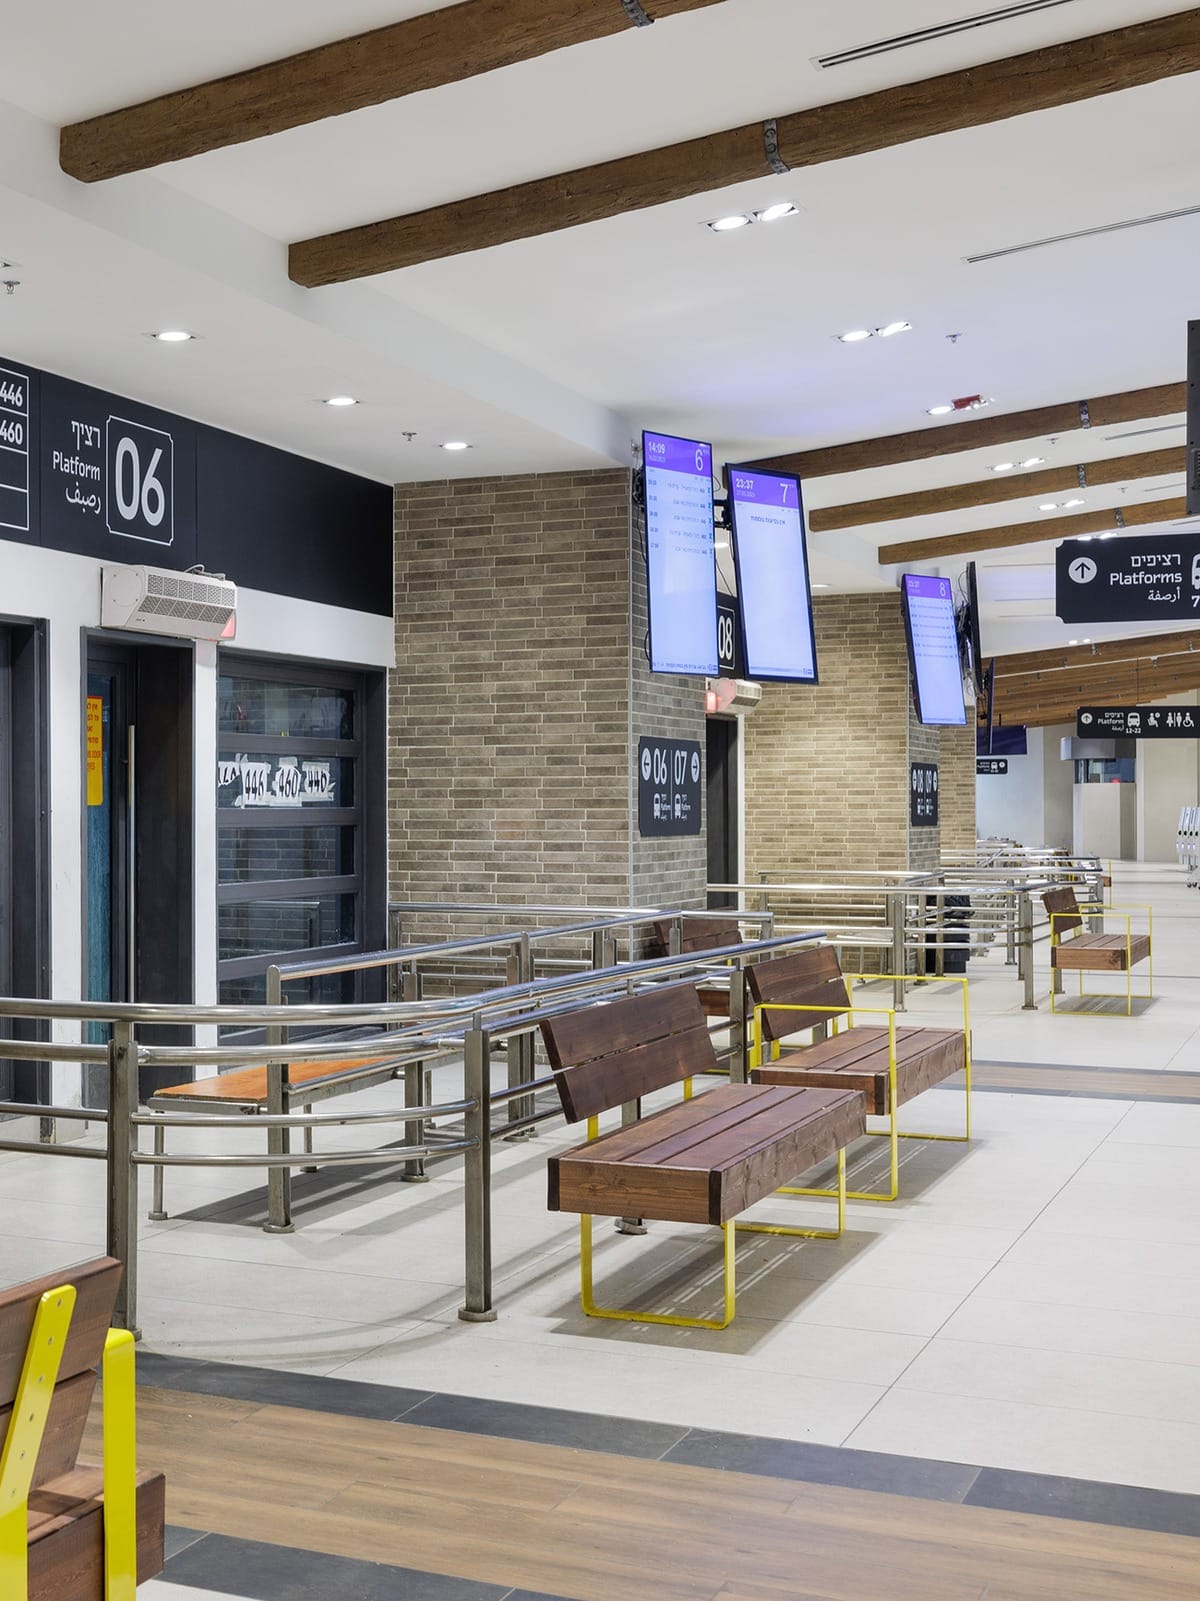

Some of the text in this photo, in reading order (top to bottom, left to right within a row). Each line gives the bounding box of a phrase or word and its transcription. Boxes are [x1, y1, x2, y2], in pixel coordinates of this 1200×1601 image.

[0, 381, 23, 407] 446
[0, 420, 23, 445] 460
[71, 420, 101, 449] רציף
[52, 450, 101, 481] Platform
[695, 448, 703, 471] 6
[115, 437, 165, 526] 06
[780, 483, 788, 504] 7
[65, 480, 101, 514] رصيف
[1130, 553, 1181, 567] רציפים
[1109, 571, 1183, 585] Platforms
[1147, 586, 1181, 602] أرصفة
[718, 615, 732, 660] 08
[654, 748, 667, 785] 06
[675, 750, 687, 785] 07
